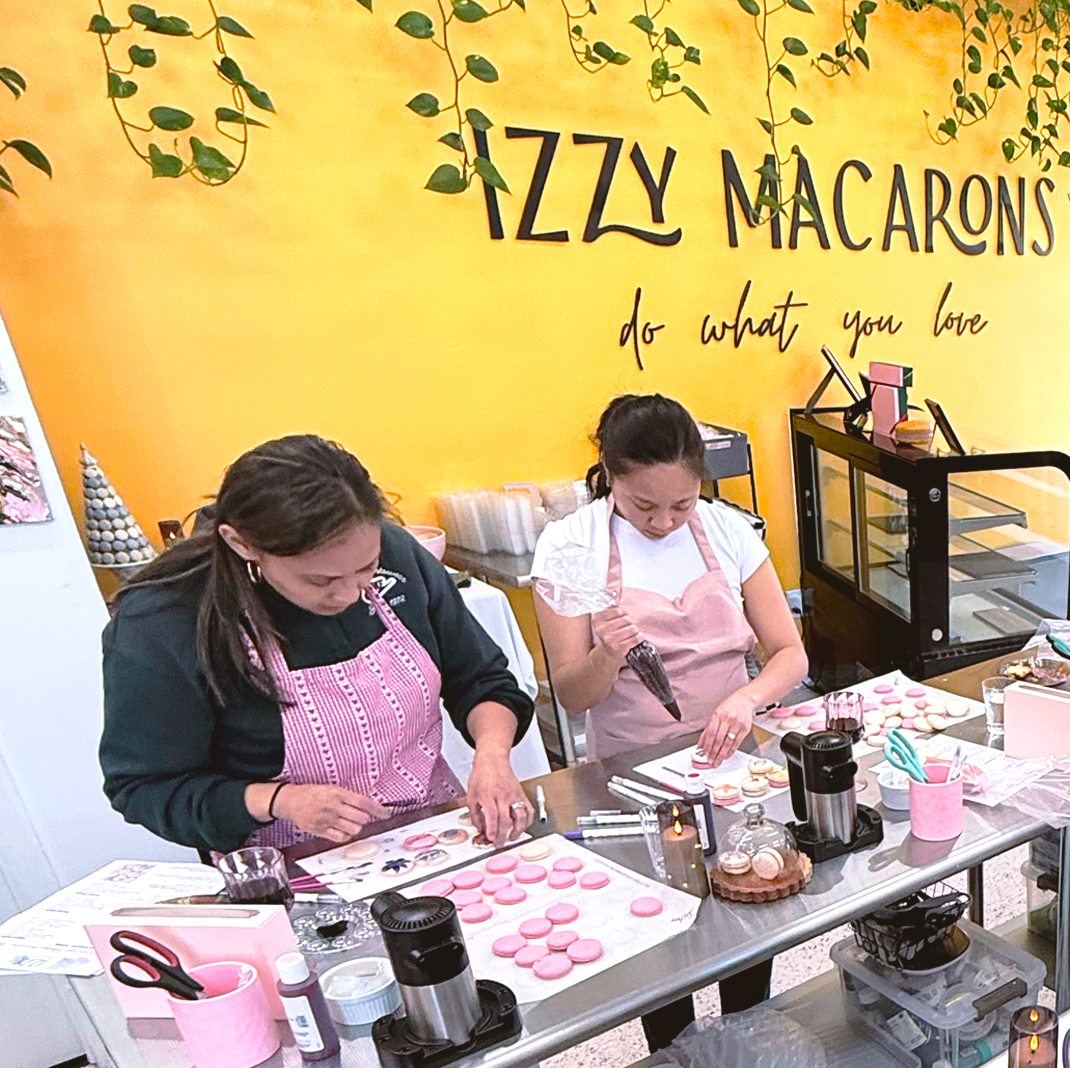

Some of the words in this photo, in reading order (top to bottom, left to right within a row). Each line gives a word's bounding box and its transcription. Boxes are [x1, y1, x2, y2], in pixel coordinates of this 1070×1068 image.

[472, 124, 682, 246] IZZY
[721, 149, 1056, 257] MACARONS
[620, 288, 665, 370] do
[701, 280, 808, 352] what
[843, 307, 902, 358] you
[933, 281, 989, 336] love
